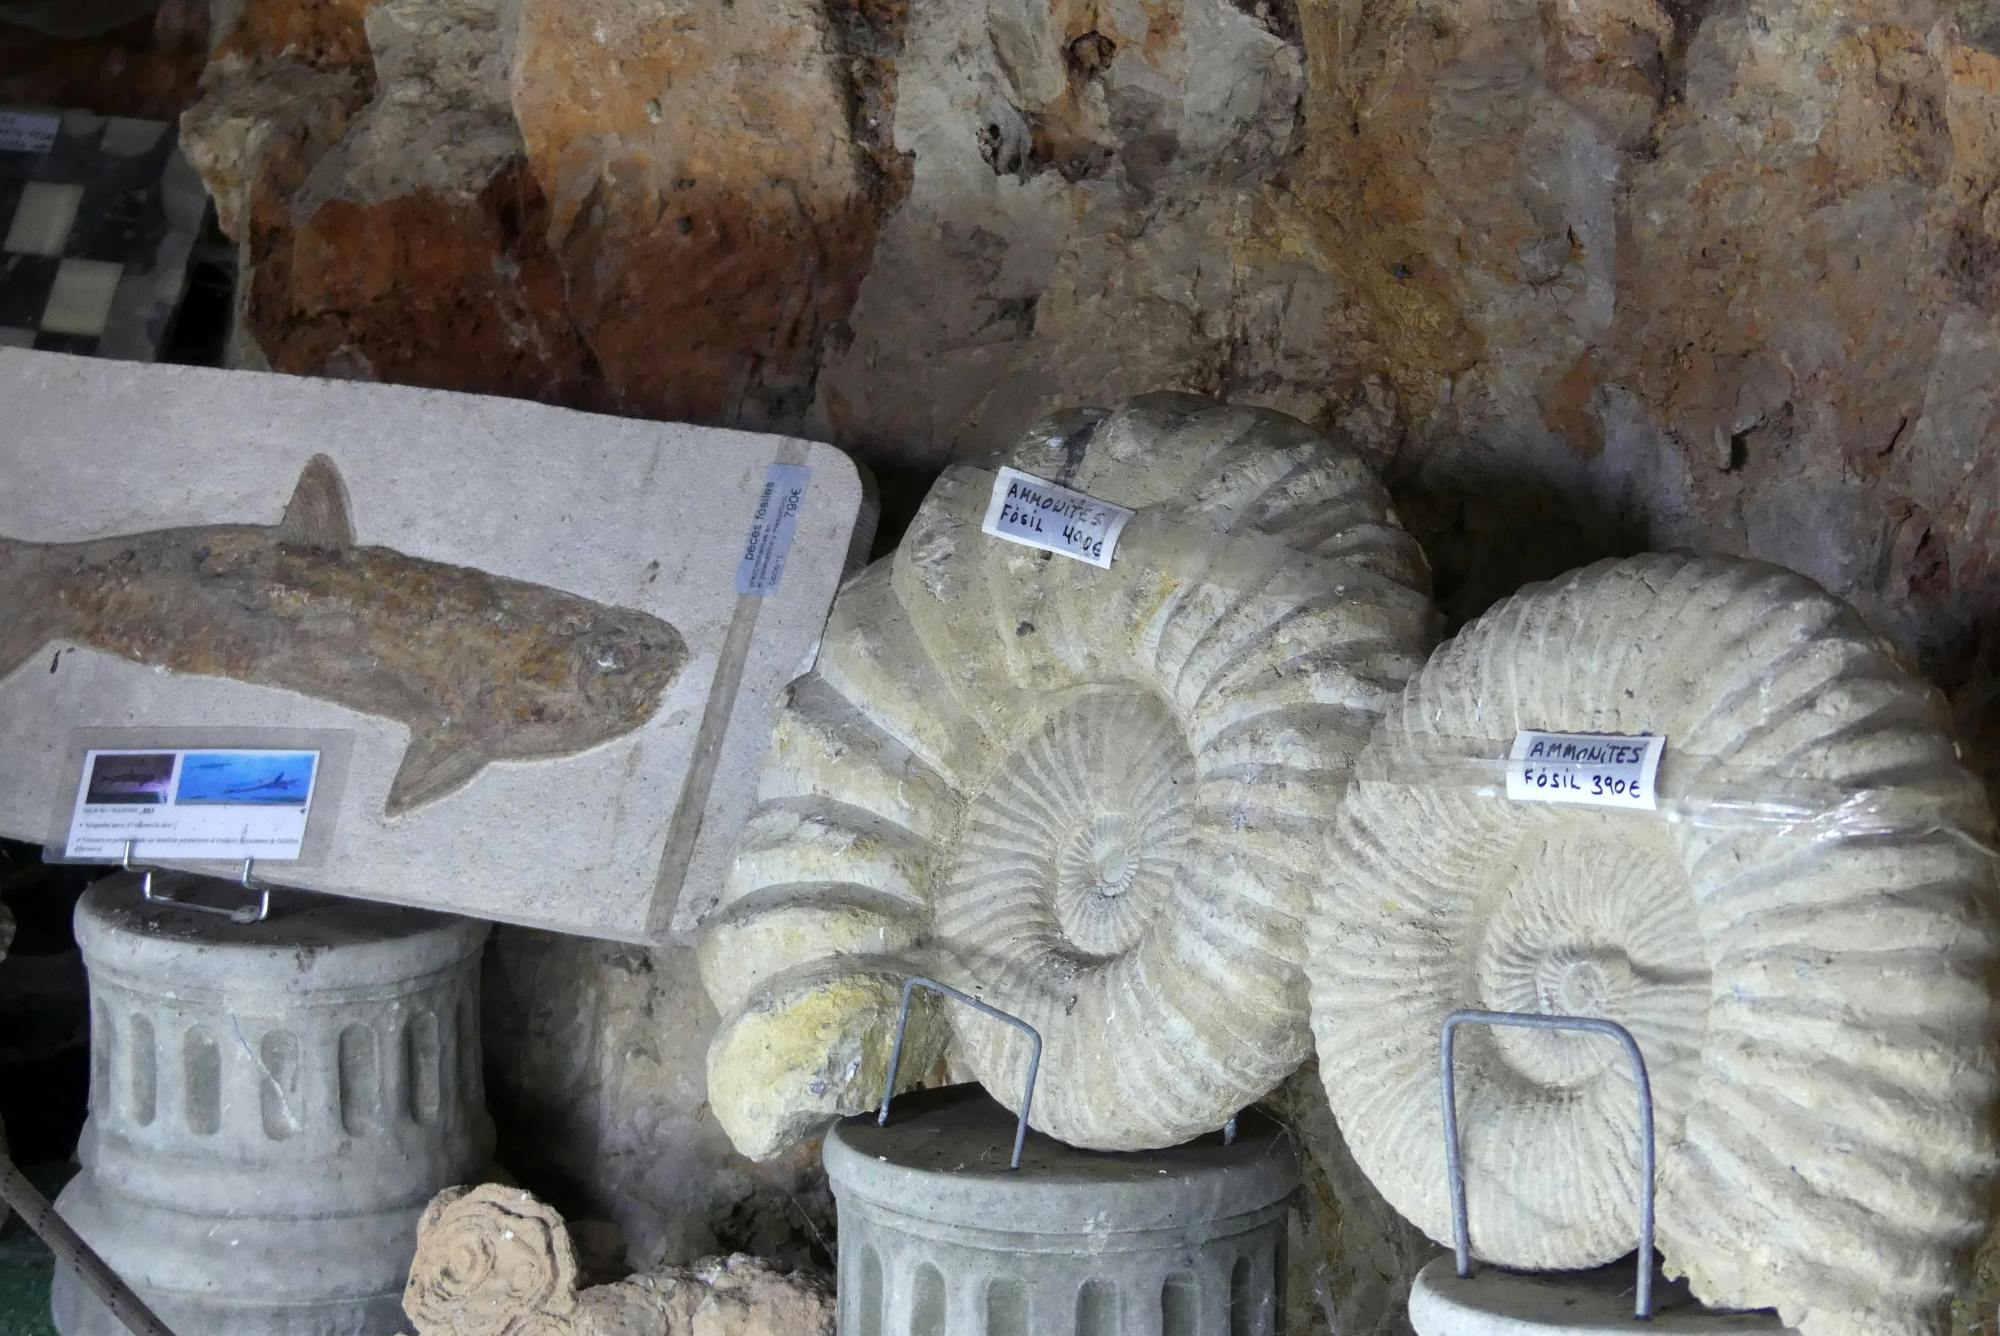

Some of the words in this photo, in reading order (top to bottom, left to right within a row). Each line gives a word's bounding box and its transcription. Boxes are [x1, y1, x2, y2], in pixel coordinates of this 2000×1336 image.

[783, 488, 801, 518] 790€
[1008, 483, 1105, 526] AMMONITES
[745, 524, 762, 561] peces
[1063, 525, 1103, 557] 400€
[1530, 741, 1643, 763] AMMONITES
[1591, 775, 1640, 798] 390€
